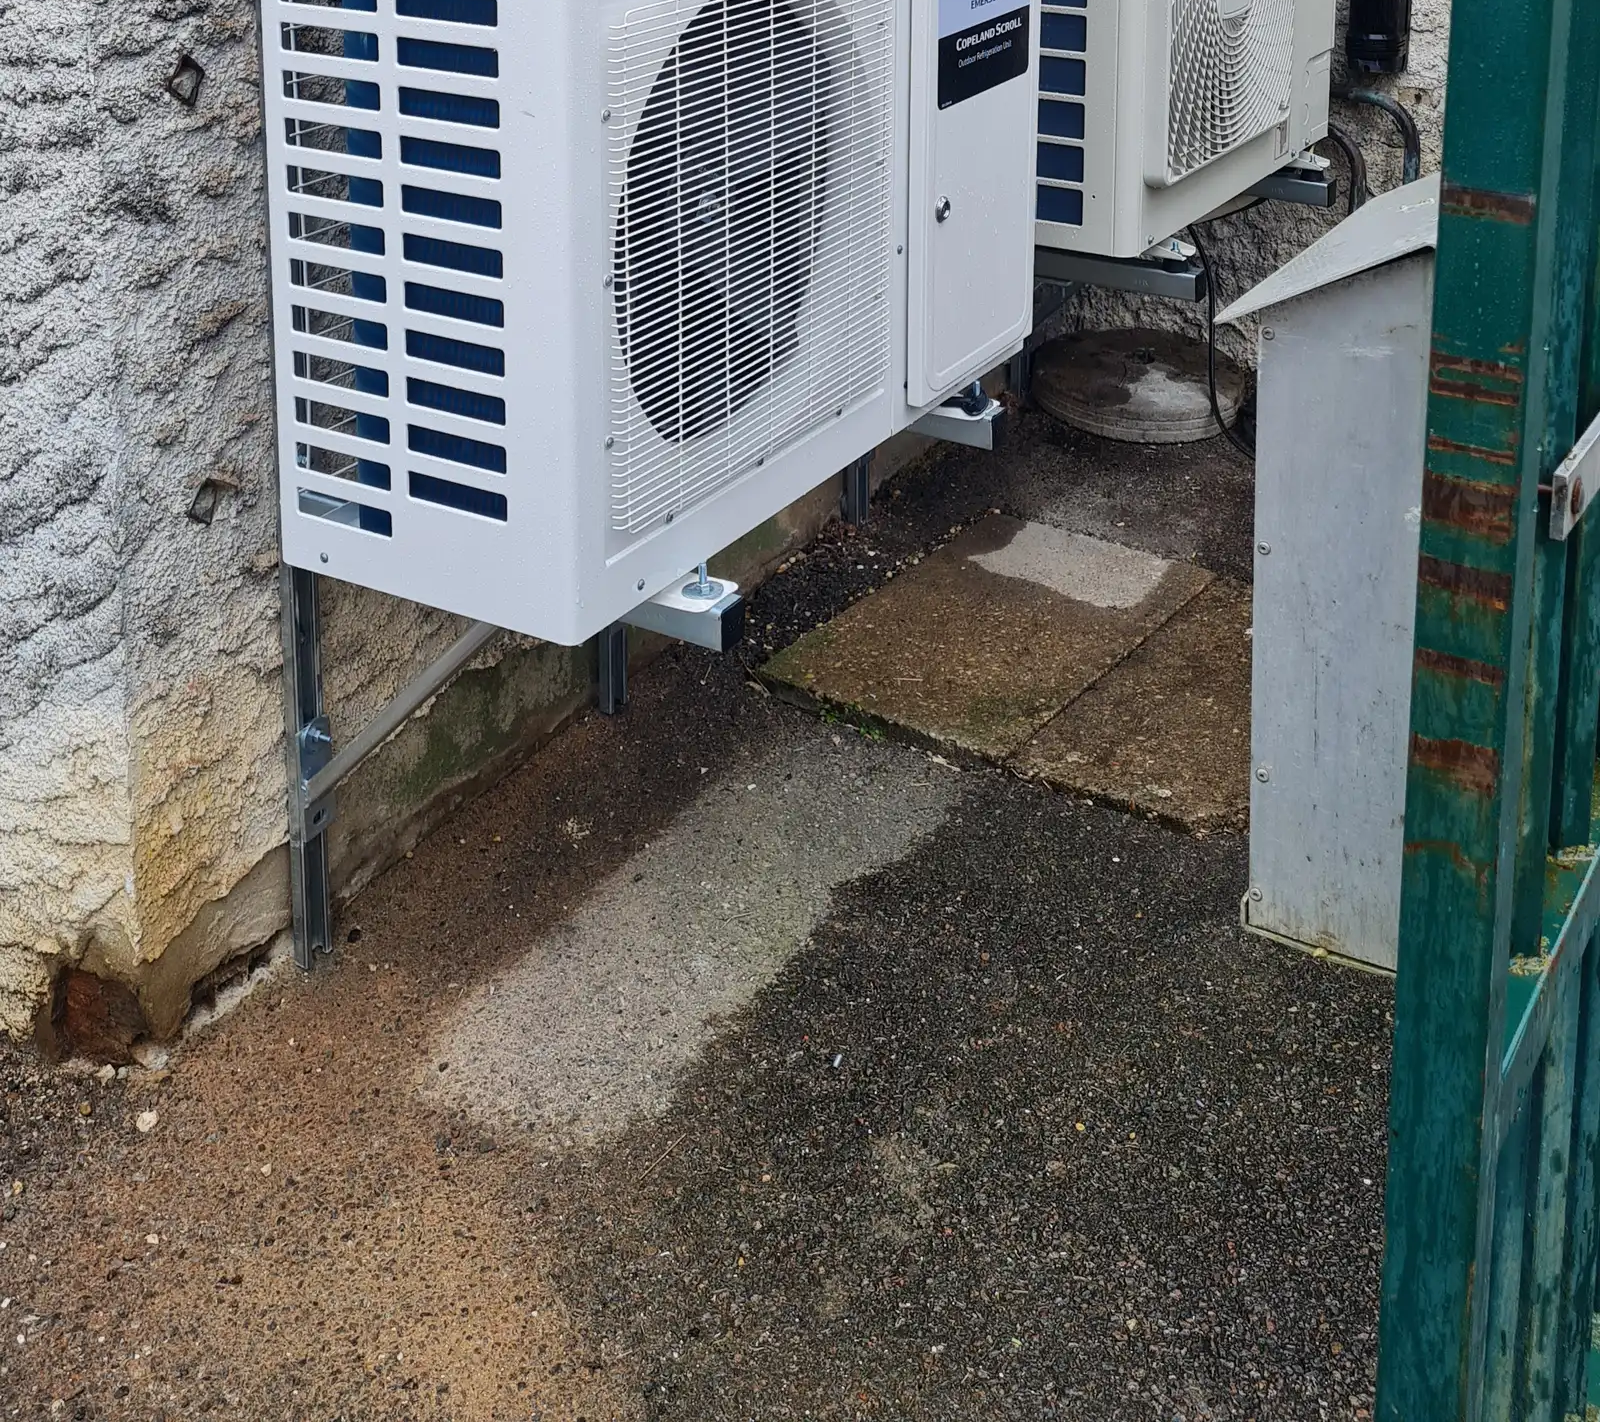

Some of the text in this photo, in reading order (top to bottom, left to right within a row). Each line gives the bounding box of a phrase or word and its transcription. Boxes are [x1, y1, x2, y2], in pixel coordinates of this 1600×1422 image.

[956, 17, 1022, 52] COPELAND SCROLL
[958, 39, 1012, 68] Outdoor Refrigeration Unit
